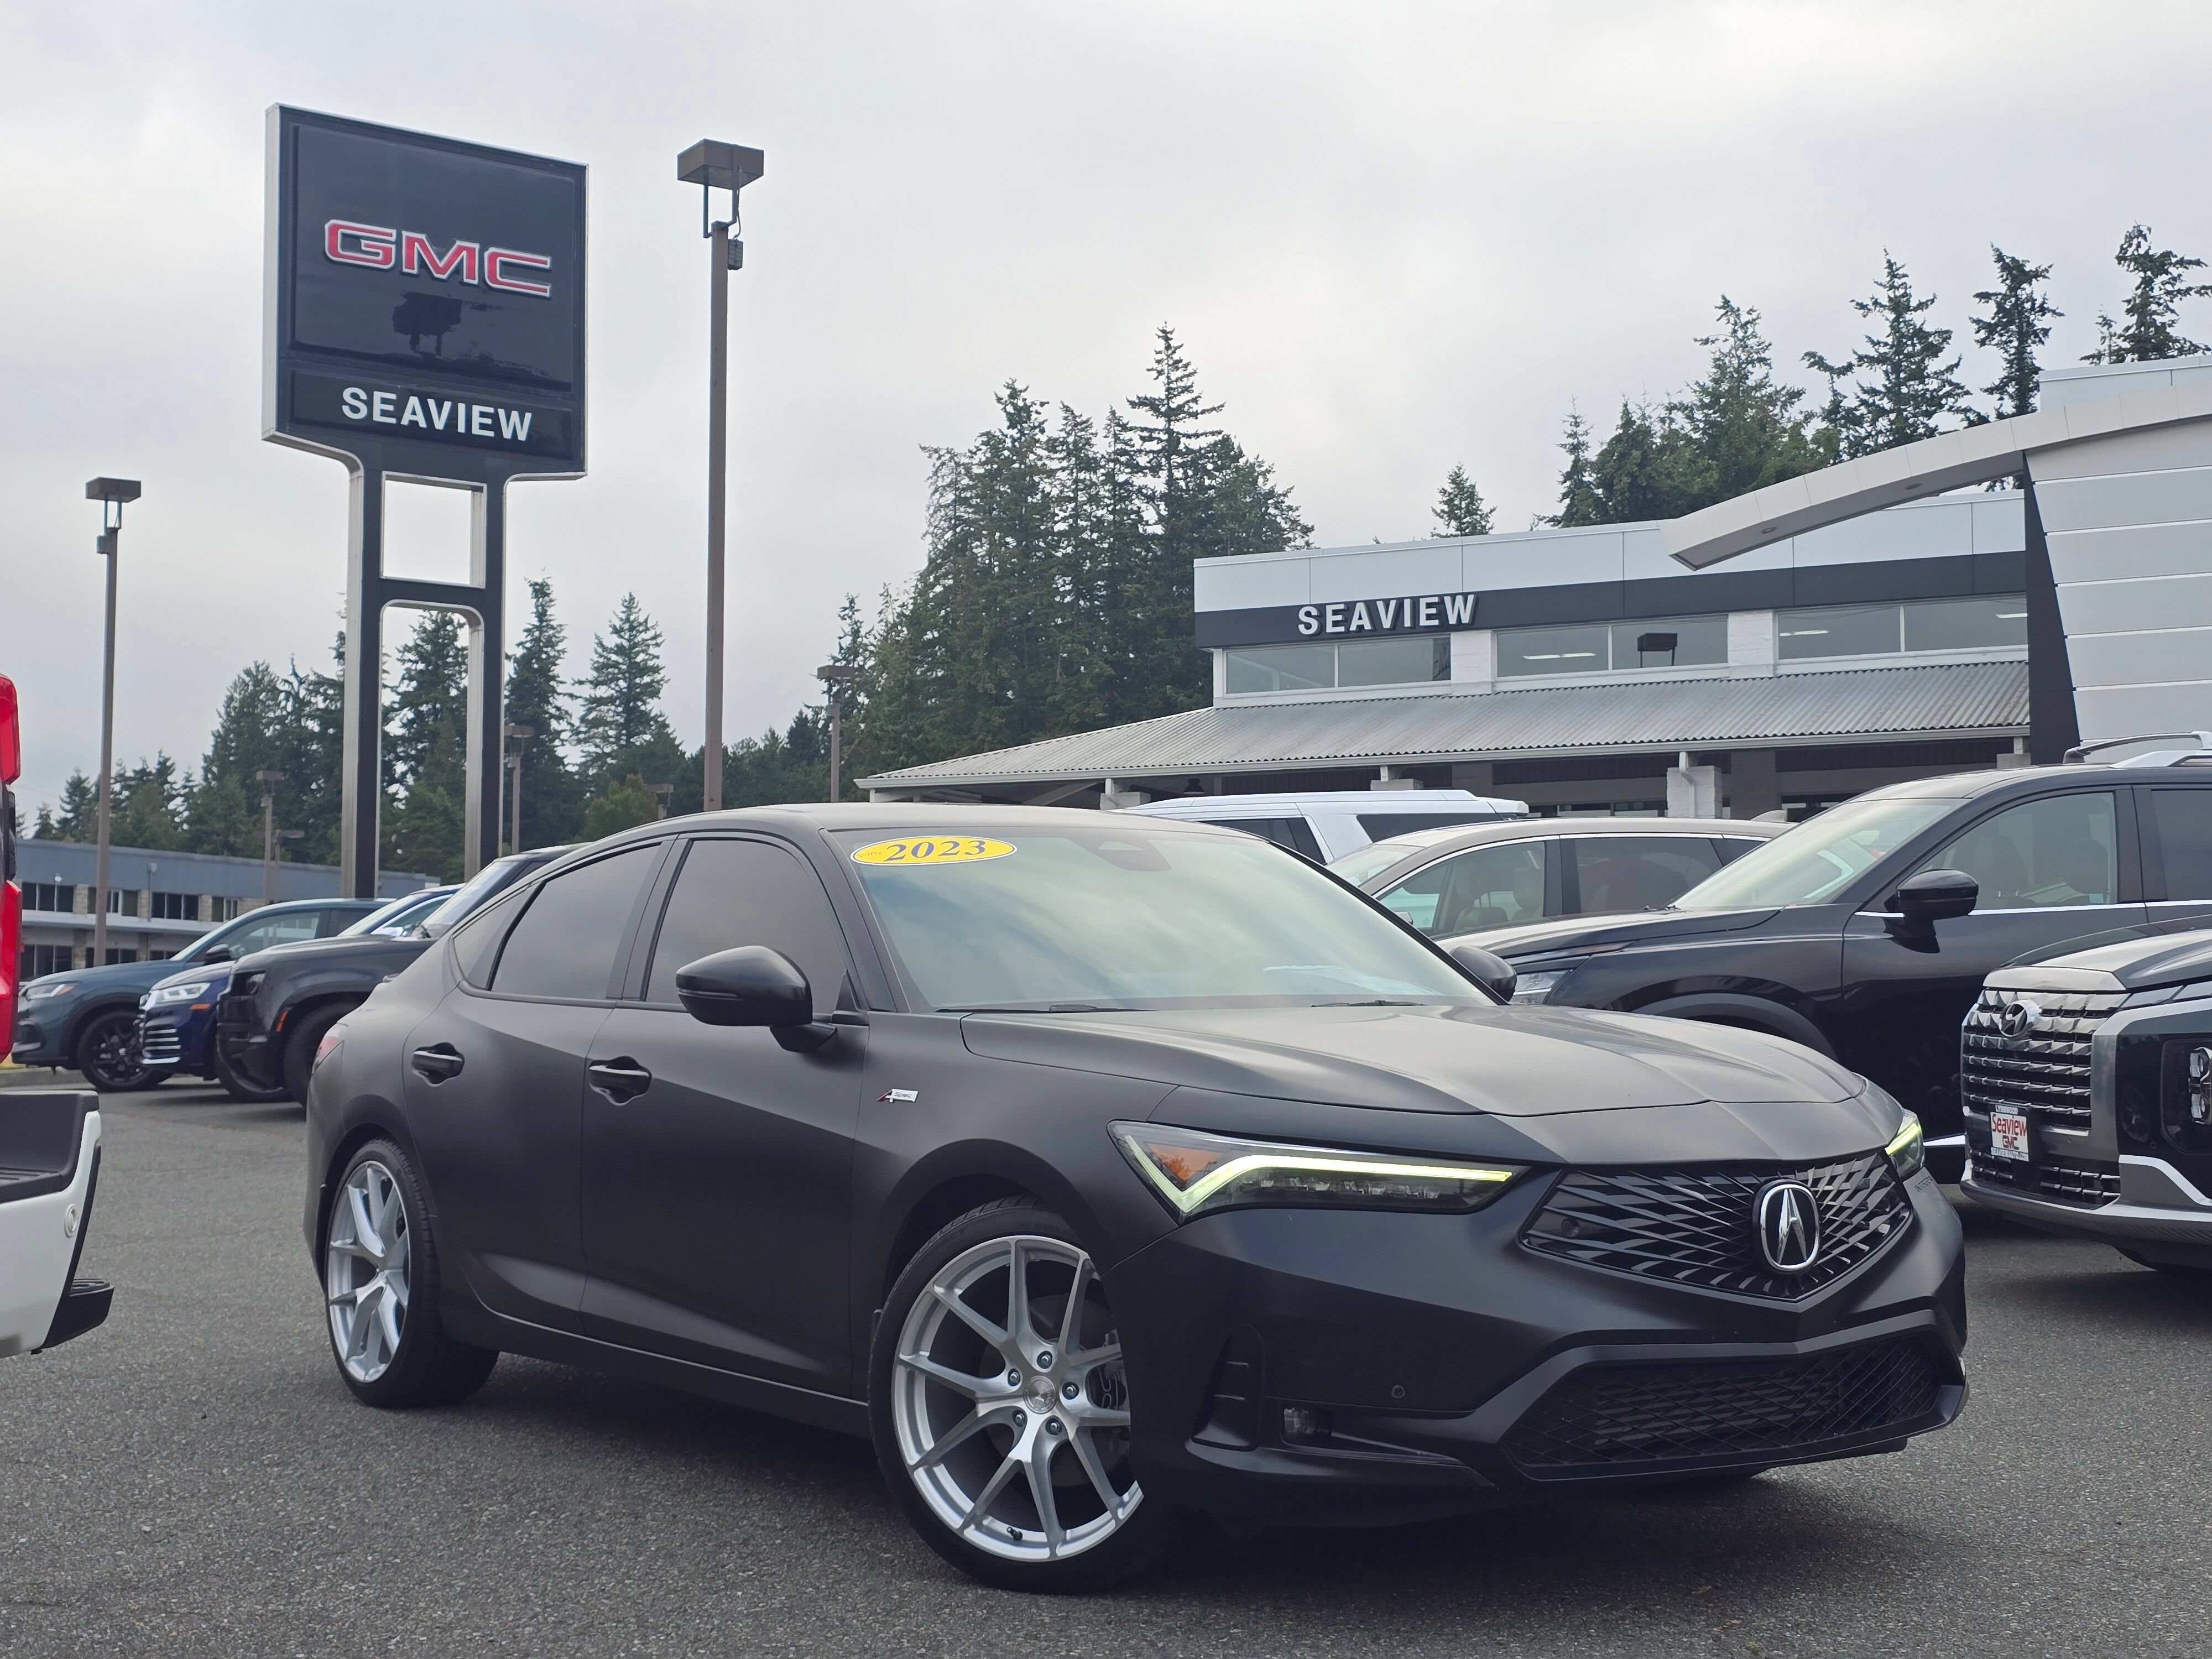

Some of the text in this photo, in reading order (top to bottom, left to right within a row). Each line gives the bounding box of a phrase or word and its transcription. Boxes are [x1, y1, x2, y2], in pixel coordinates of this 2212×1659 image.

[324, 219, 551, 298] GMC
[342, 387, 532, 442] SEAVIEW
[1298, 594, 1477, 635] SEAVIEW
[883, 840, 986, 862] 2023
[1992, 1113, 2027, 1137] Seaview
[2002, 1135, 2020, 1150] GMC
